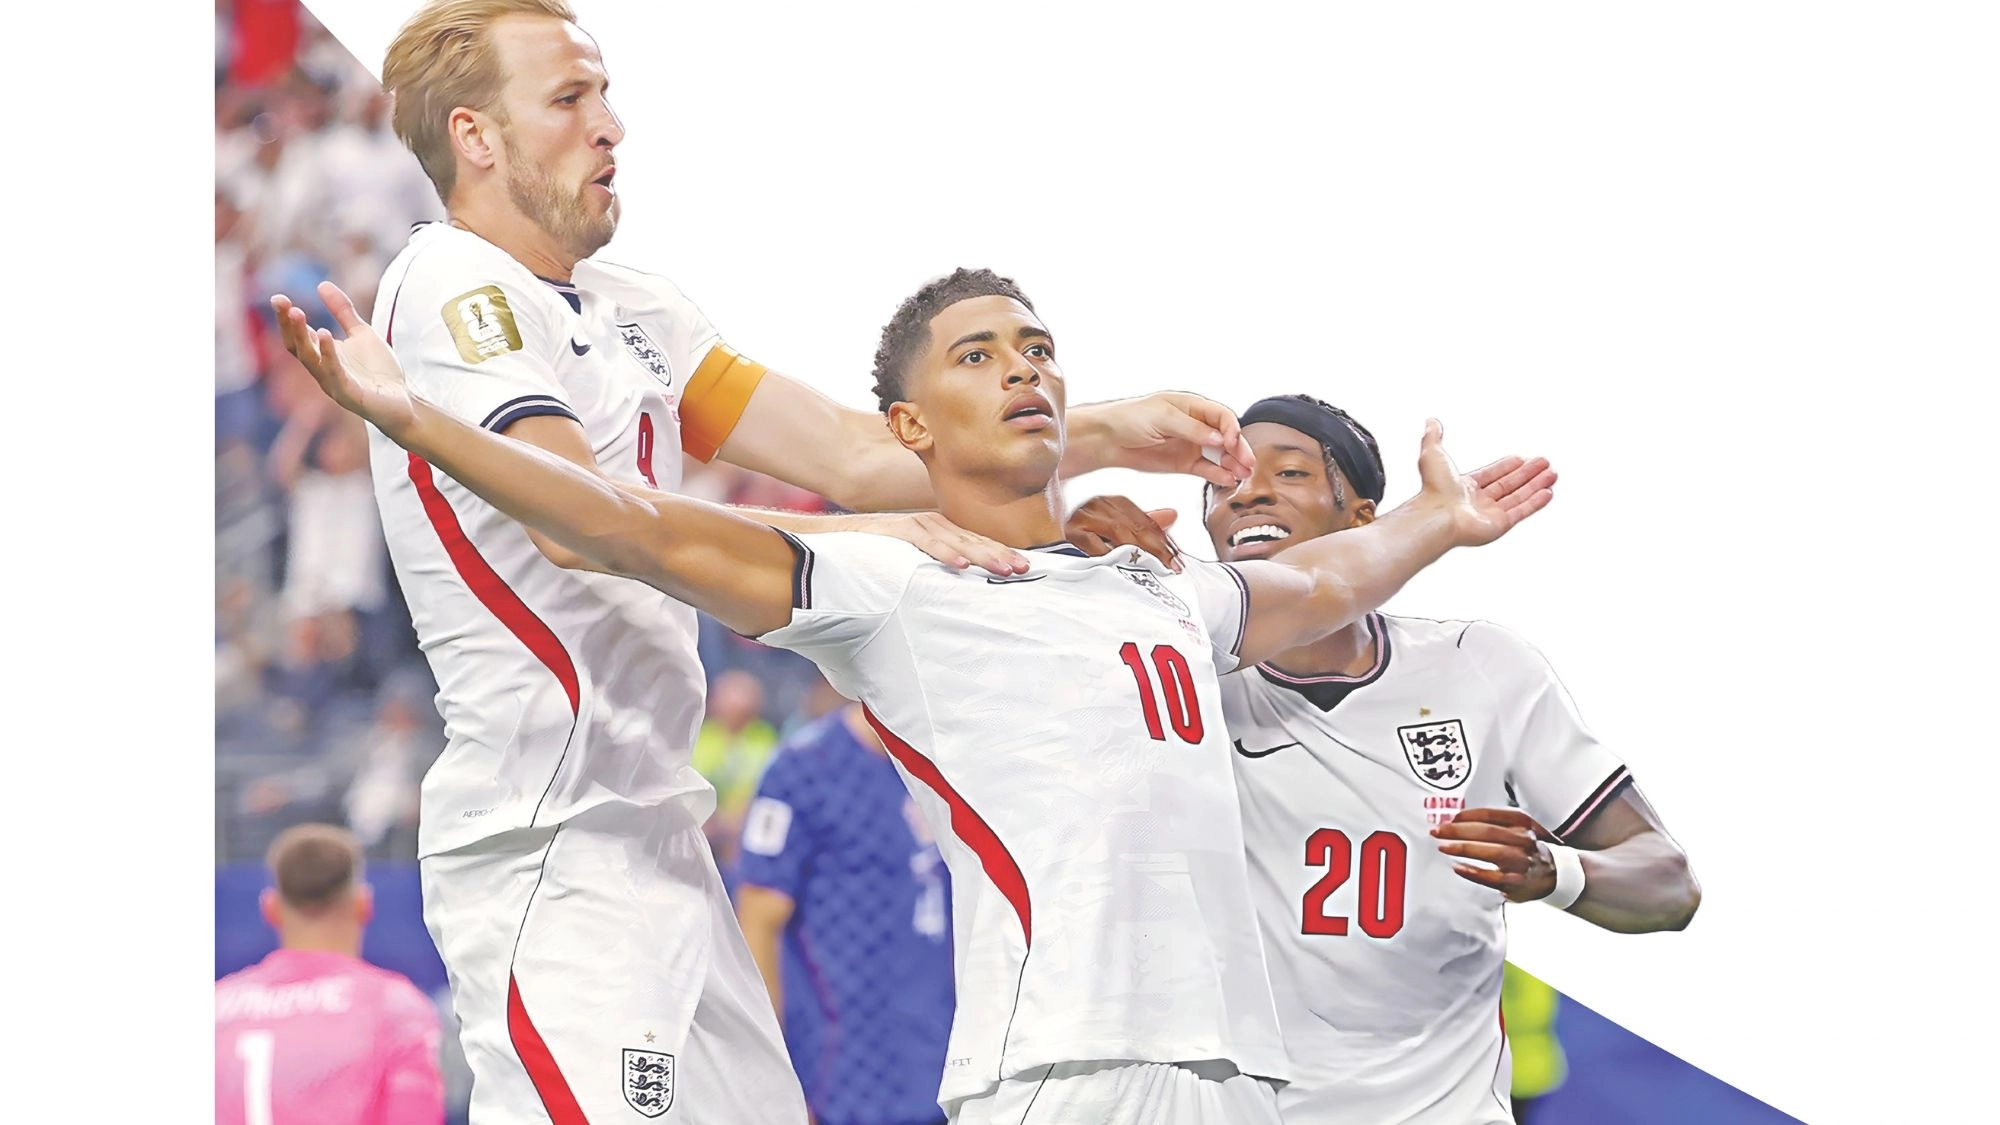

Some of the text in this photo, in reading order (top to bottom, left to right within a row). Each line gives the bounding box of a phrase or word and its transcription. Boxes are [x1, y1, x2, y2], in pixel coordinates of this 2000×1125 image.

[637, 411, 657, 489] 9
[1118, 641, 1205, 745] 10
[1301, 827, 1408, 939] 20
[235, 1030, 274, 1125] 1
